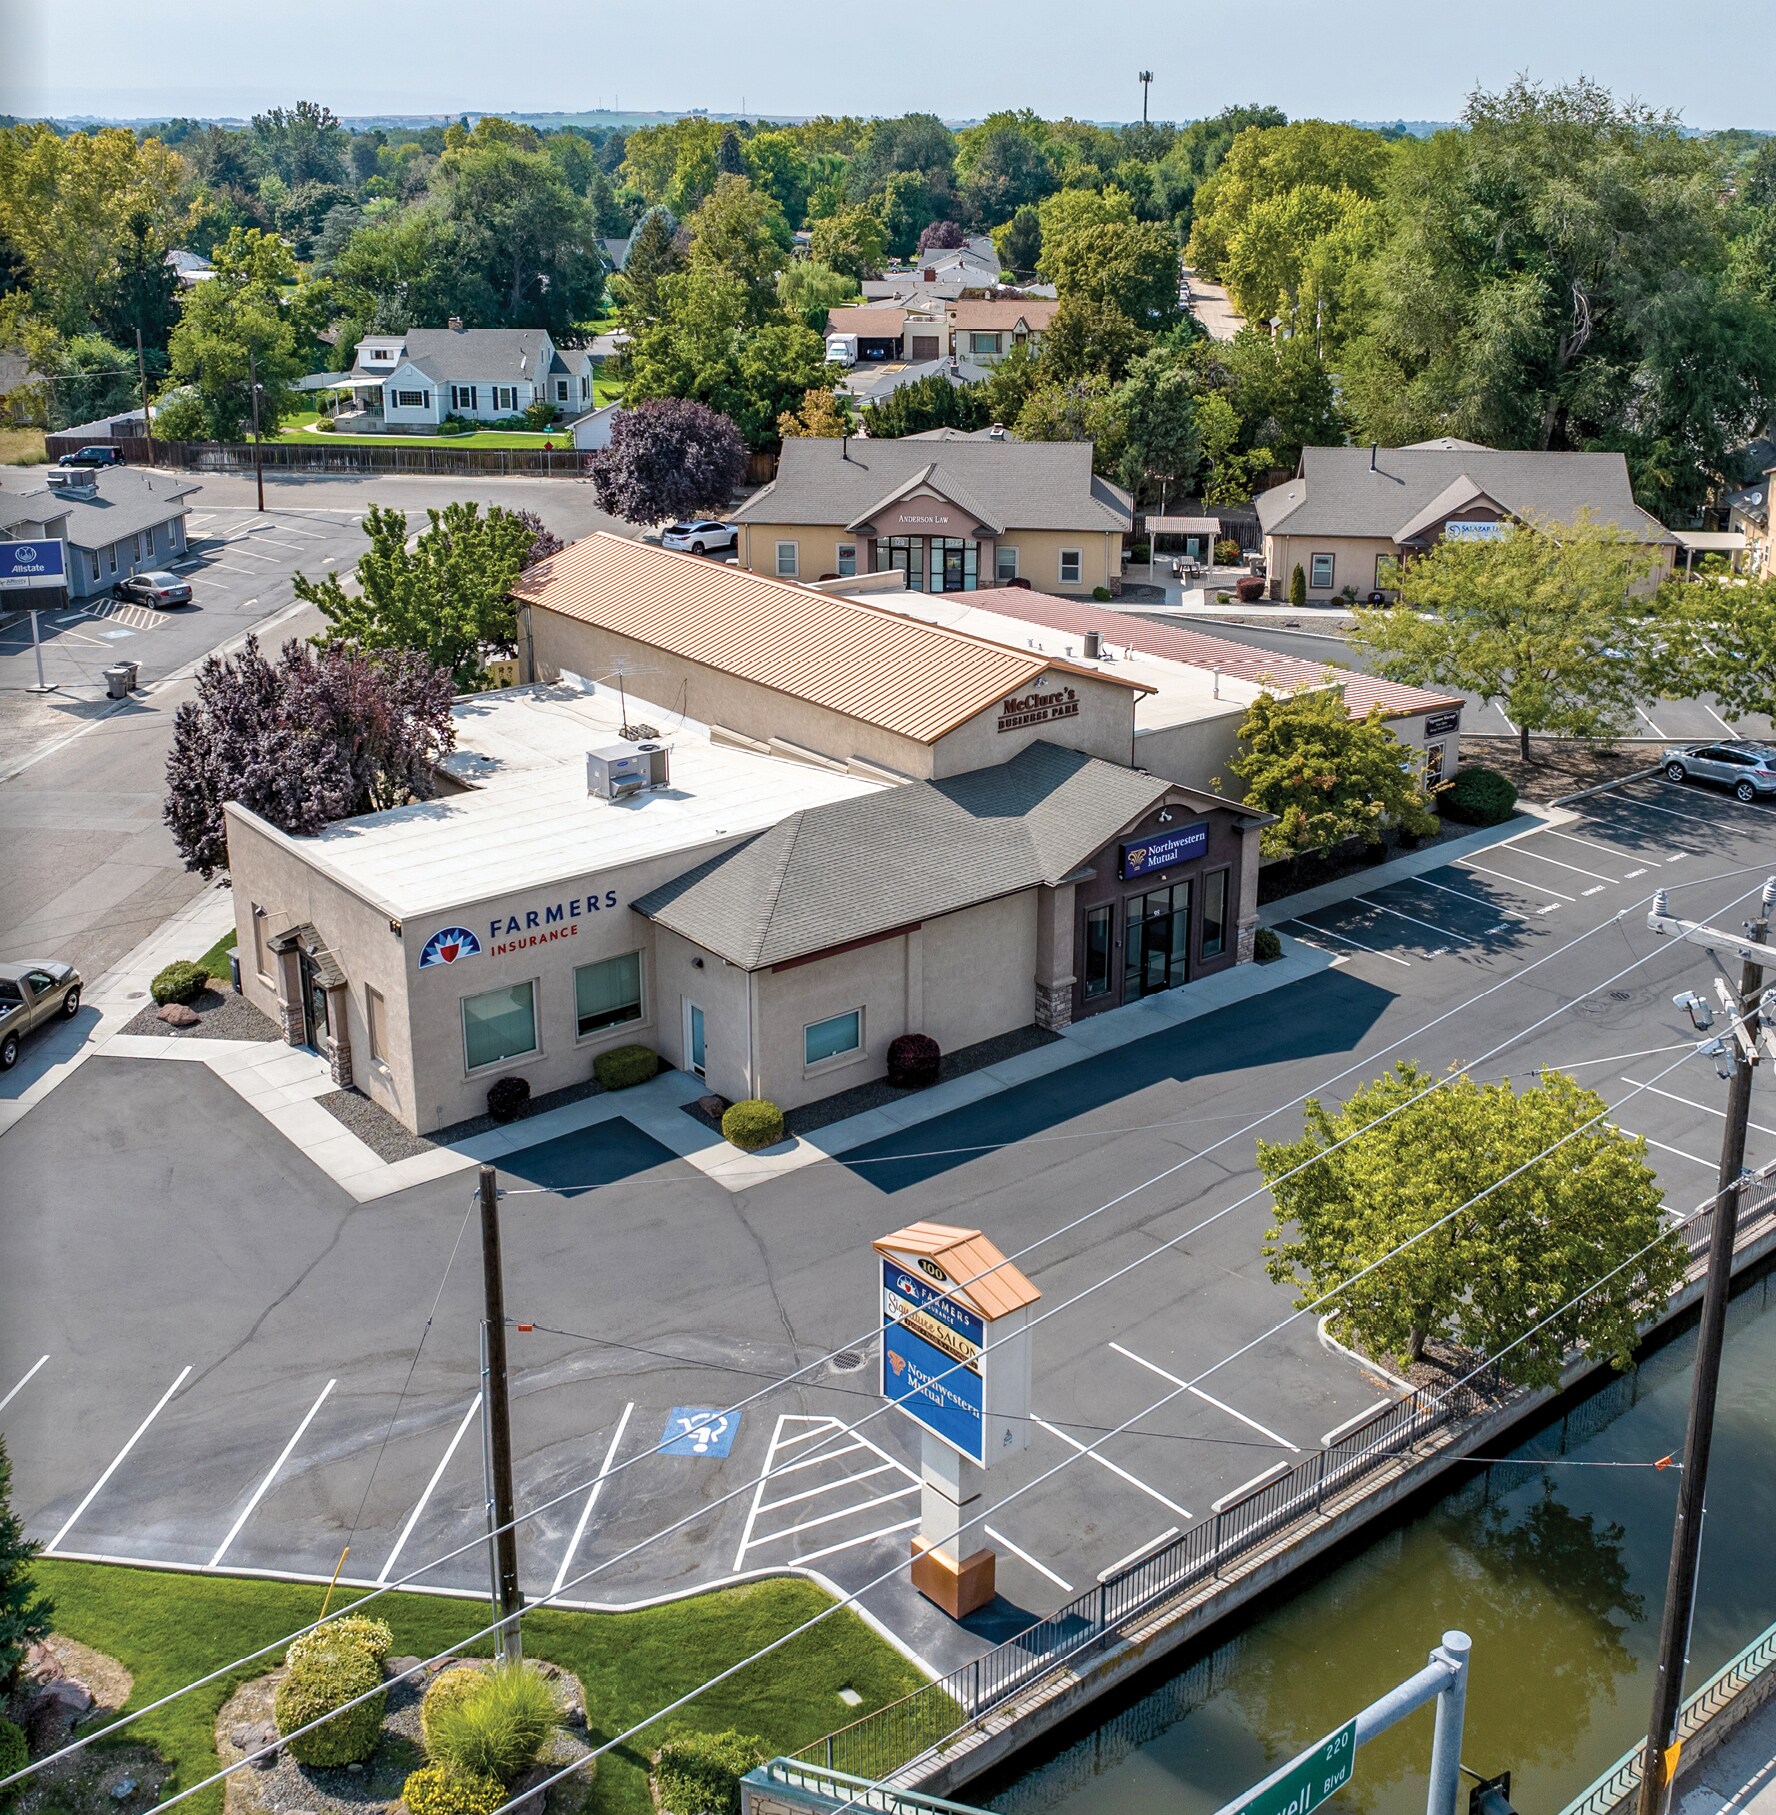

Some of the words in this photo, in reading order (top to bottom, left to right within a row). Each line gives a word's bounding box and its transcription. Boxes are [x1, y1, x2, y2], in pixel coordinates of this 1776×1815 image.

[899, 515, 933, 523] ANDERSON
[935, 515, 949, 524] LAW
[12, 565, 45, 573] Allstate
[1003, 687, 1075, 715] McClure's
[998, 710, 1048, 730] BUSINESS
[1051, 703, 1079, 717] PARK
[1147, 849, 1178, 867] Mutual
[1148, 833, 1205, 856] Northwestern
[490, 890, 617, 938] FARMERS
[491, 924, 578, 957] INSURANCE
[920, 1260, 943, 1280] 100
[936, 1326, 979, 1362] SALON
[907, 1360, 980, 1420] Northwestern
[1325, 1731, 1349, 1761] 220
[1323, 1765, 1346, 1794] Blvd
